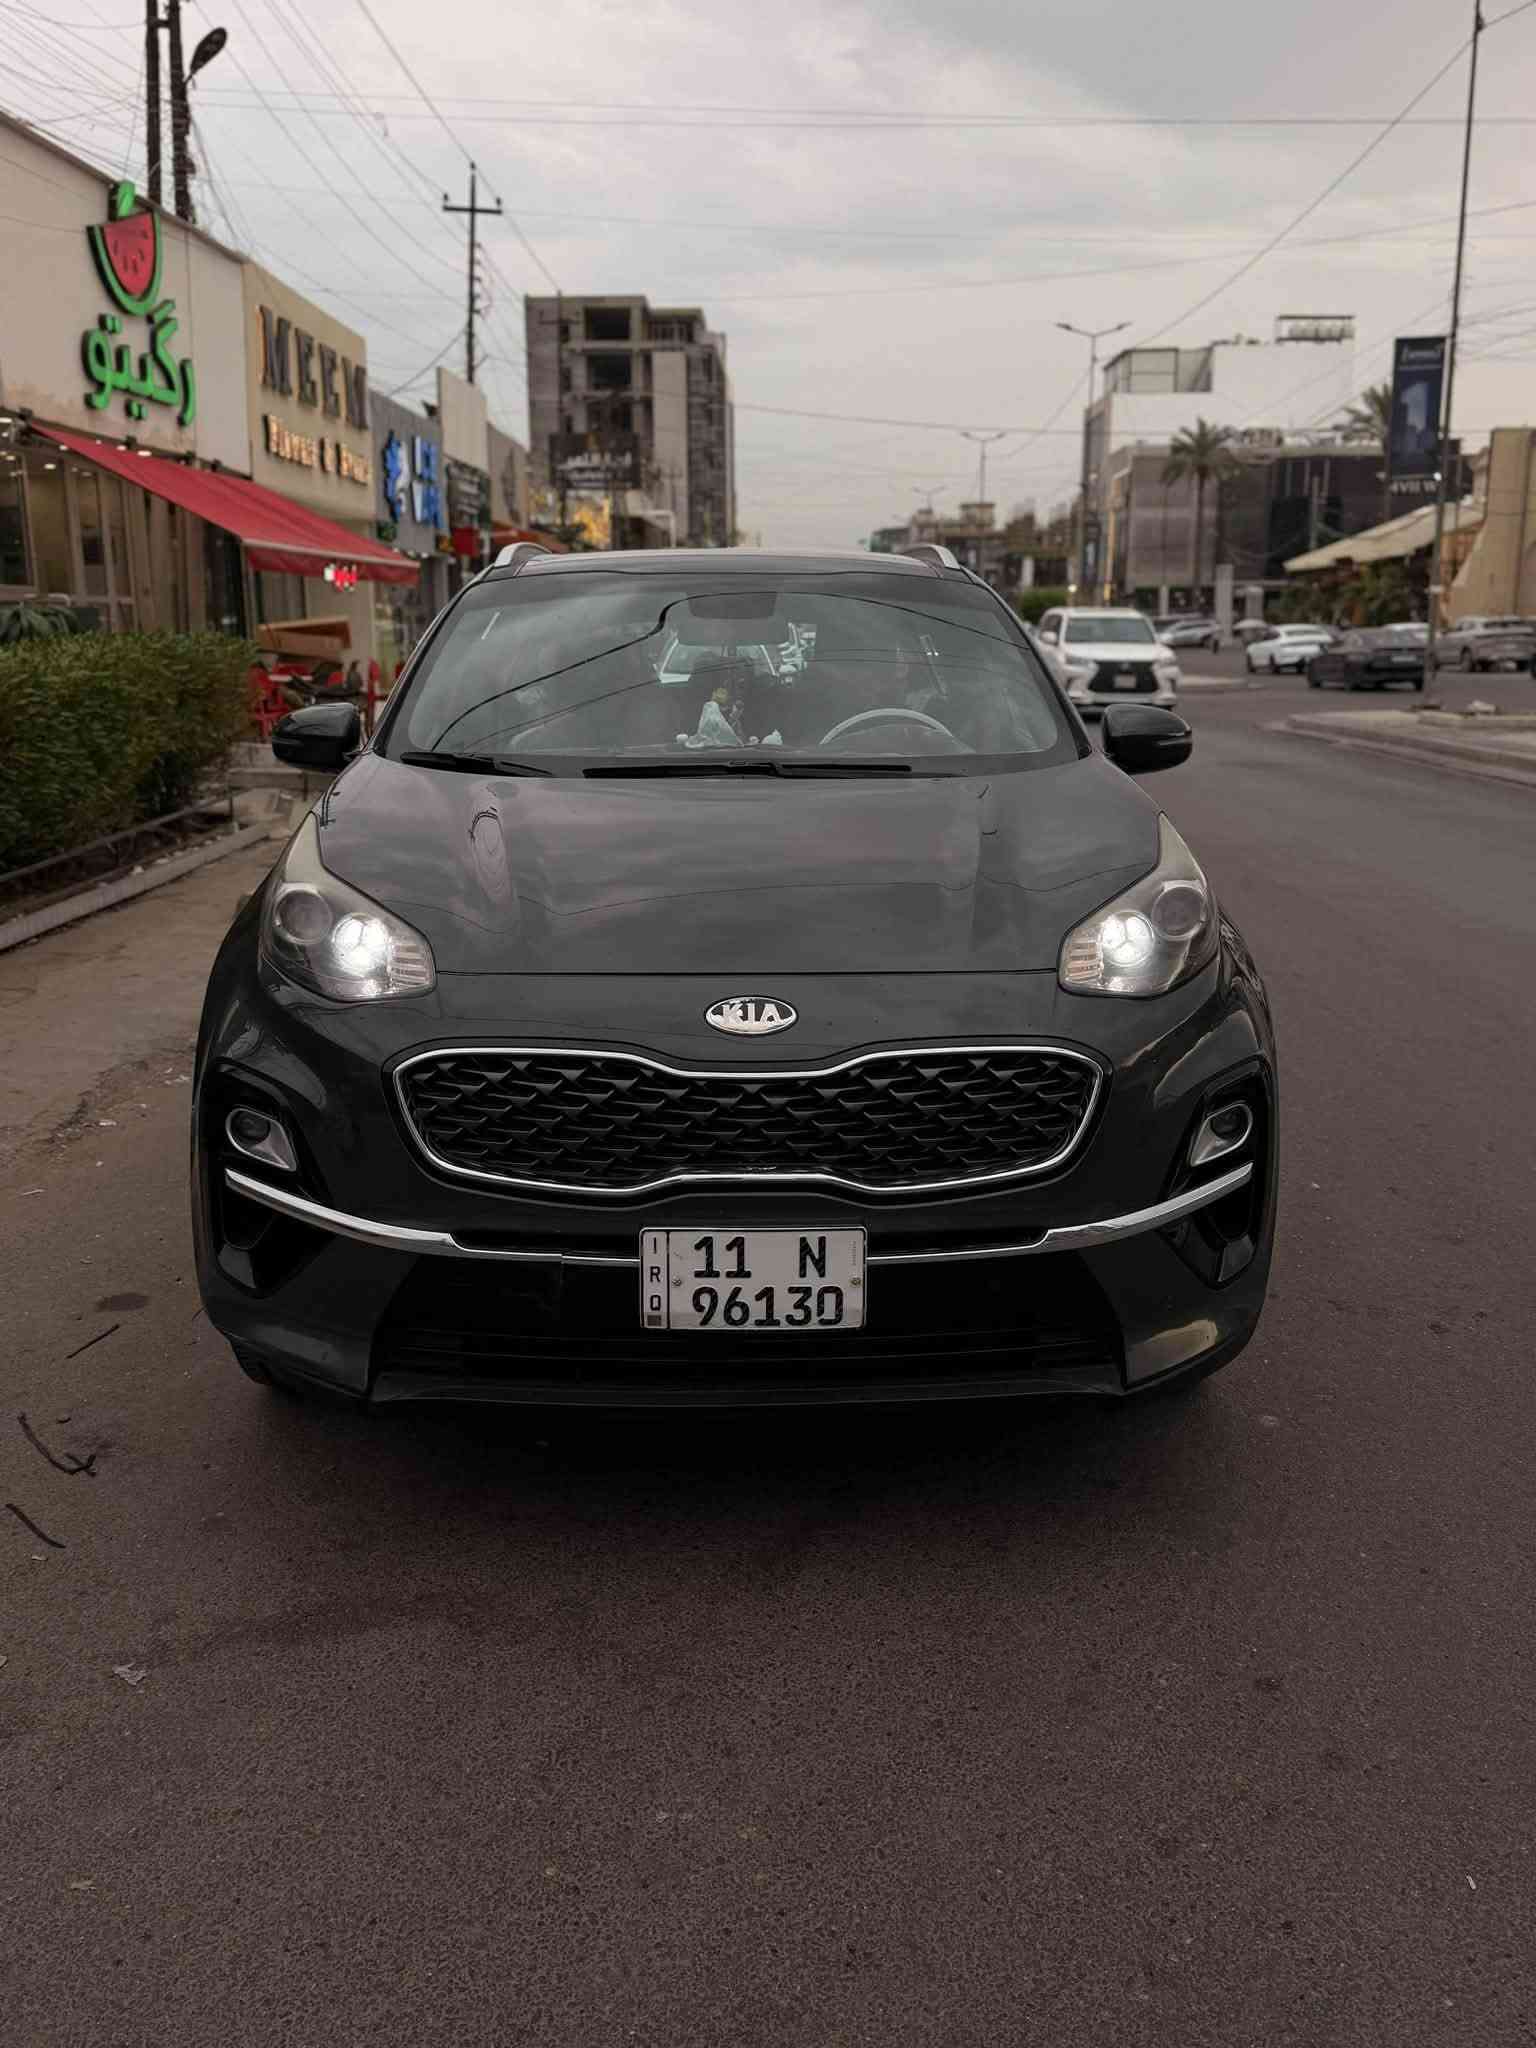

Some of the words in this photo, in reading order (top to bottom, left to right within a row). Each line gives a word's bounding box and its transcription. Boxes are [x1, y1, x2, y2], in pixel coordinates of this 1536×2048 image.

[721, 1003, 785, 1025] KIA
[693, 1236, 752, 1278] 11
[799, 1236, 826, 1278] N
[692, 1286, 844, 1326] 96130
